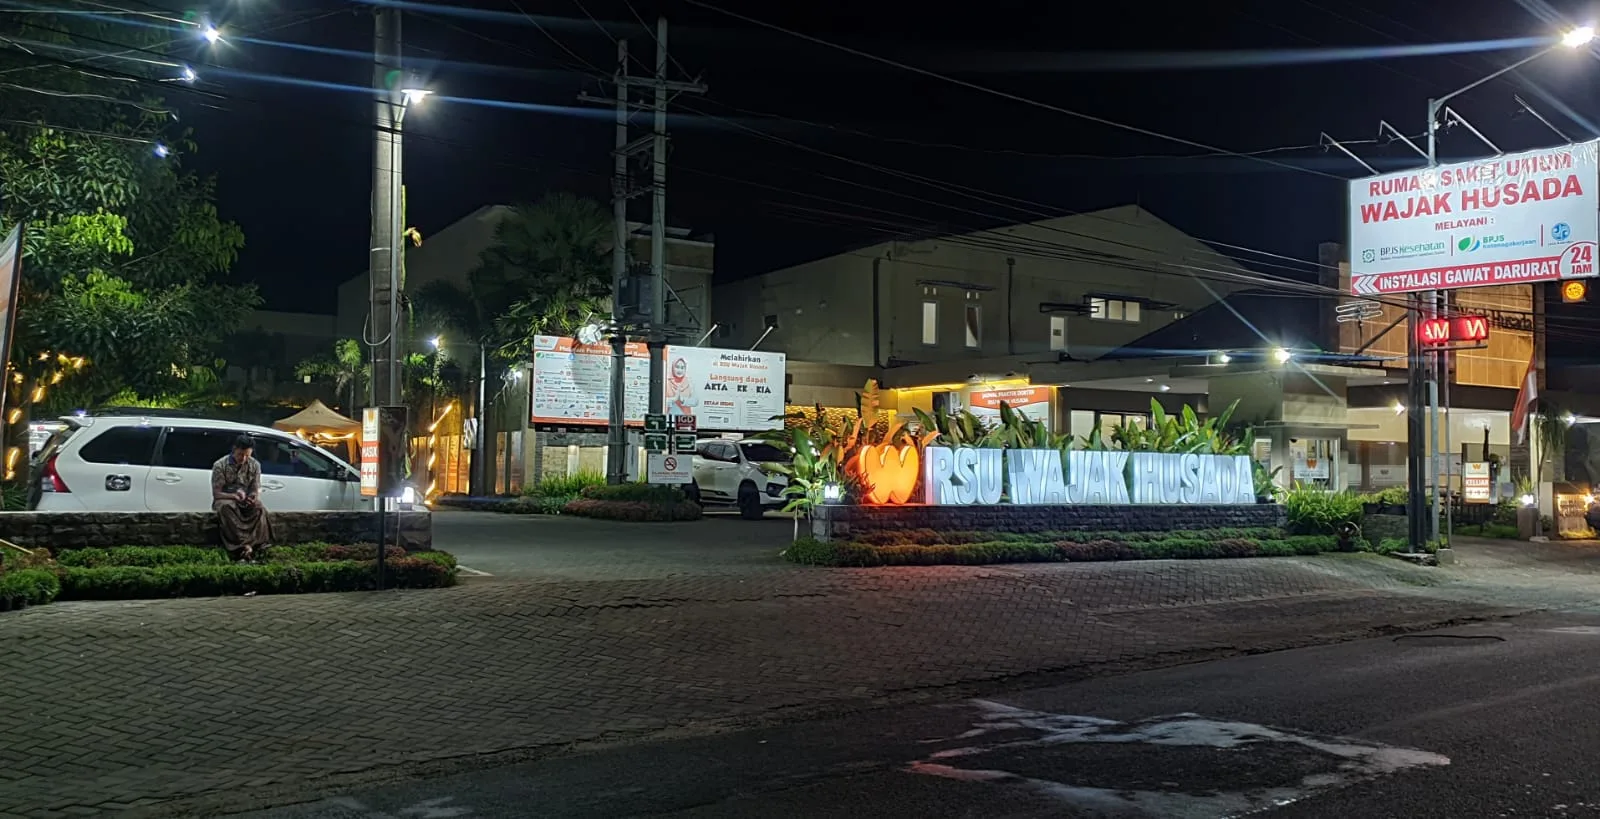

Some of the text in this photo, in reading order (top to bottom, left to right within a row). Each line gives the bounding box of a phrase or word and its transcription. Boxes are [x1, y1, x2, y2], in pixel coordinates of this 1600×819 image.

[1369, 172, 1436, 197] RUMA
[1361, 174, 1583, 224] WAJAK HUSADA
[1435, 216, 1488, 231] MELAYANI
[1482, 234, 1505, 243] BPJS
[1380, 246, 1399, 257] BPJS
[1570, 245, 1593, 264] 24
[1379, 260, 1558, 290] INSTALASI GAWAT DARURAT
[1571, 263, 1593, 275] JAM
[720, 353, 761, 363] Melahirkan
[710, 373, 767, 384] Langsung dapat
[704, 382, 728, 391] AKTA
[756, 386, 771, 394] KIA
[677, 415, 694, 424] IGD
[926, 447, 1002, 504] RSU
[1008, 449, 1131, 504] WAJAK
[1134, 452, 1256, 504] HUSADA
